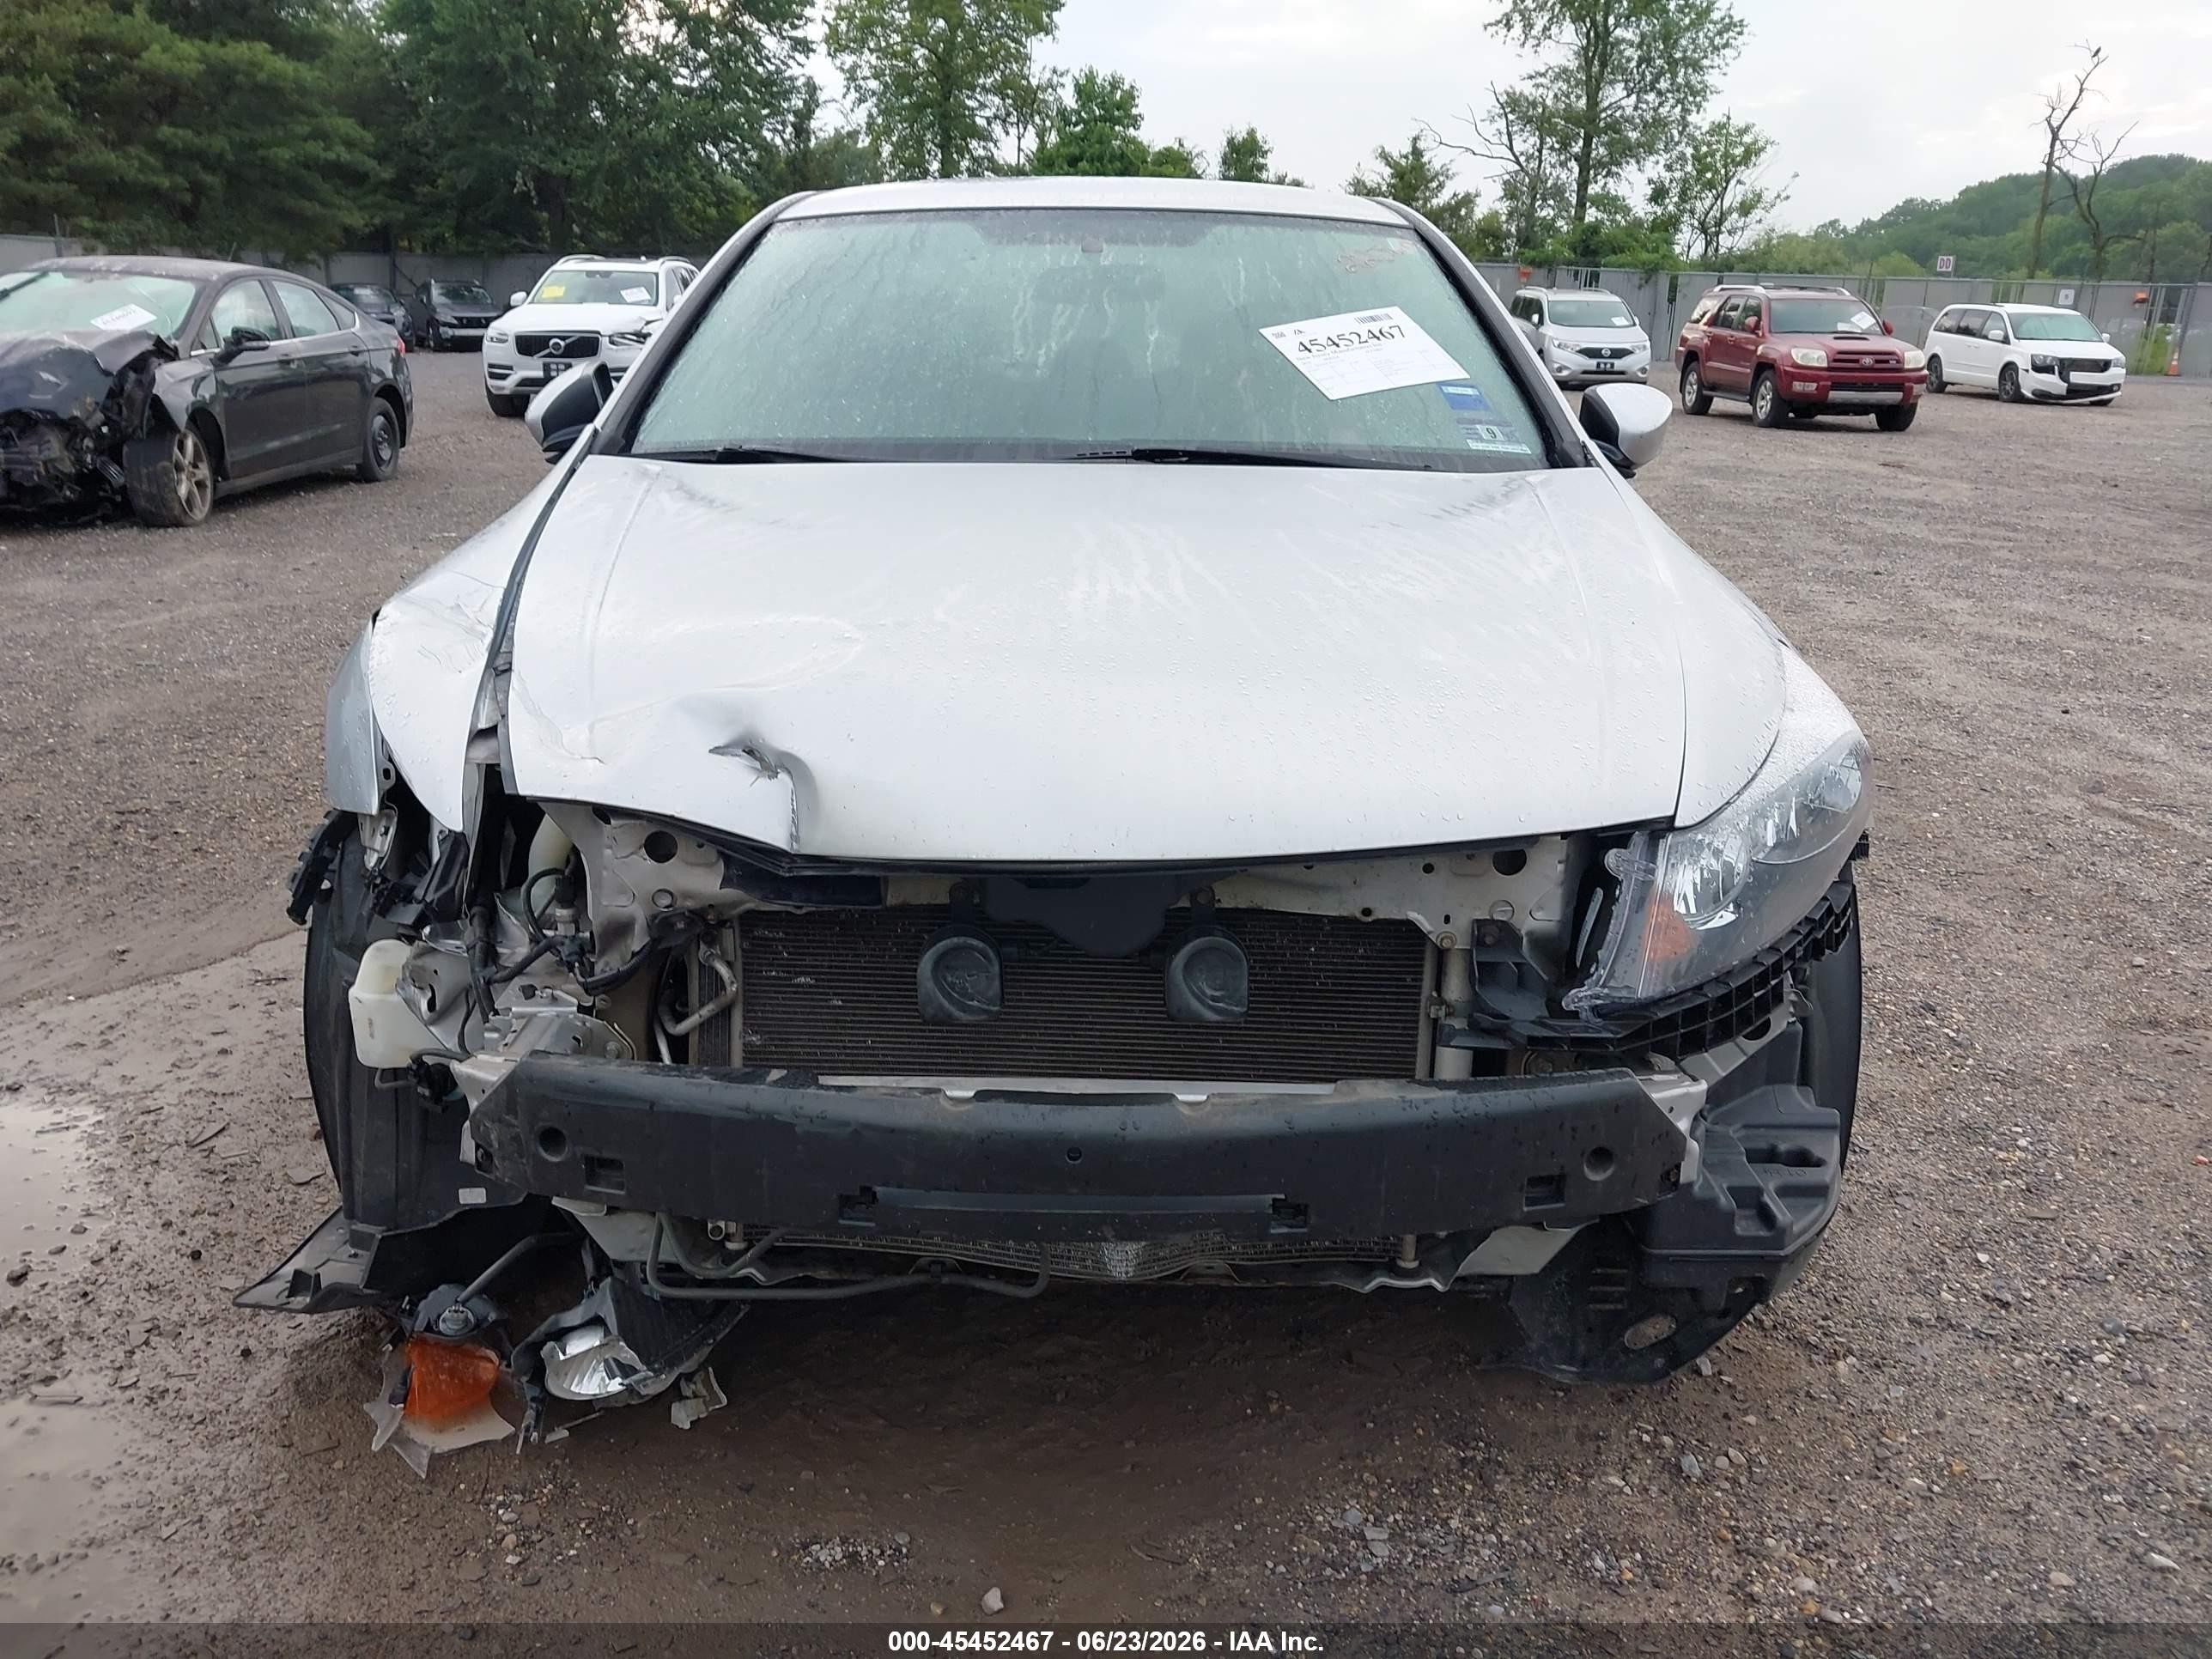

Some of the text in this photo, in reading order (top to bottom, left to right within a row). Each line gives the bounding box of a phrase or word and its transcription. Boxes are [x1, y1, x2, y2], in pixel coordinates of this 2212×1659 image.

[1938, 257, 1952, 270] DD
[1297, 324, 1407, 354] 45452467
[1486, 427, 1498, 440] 9
